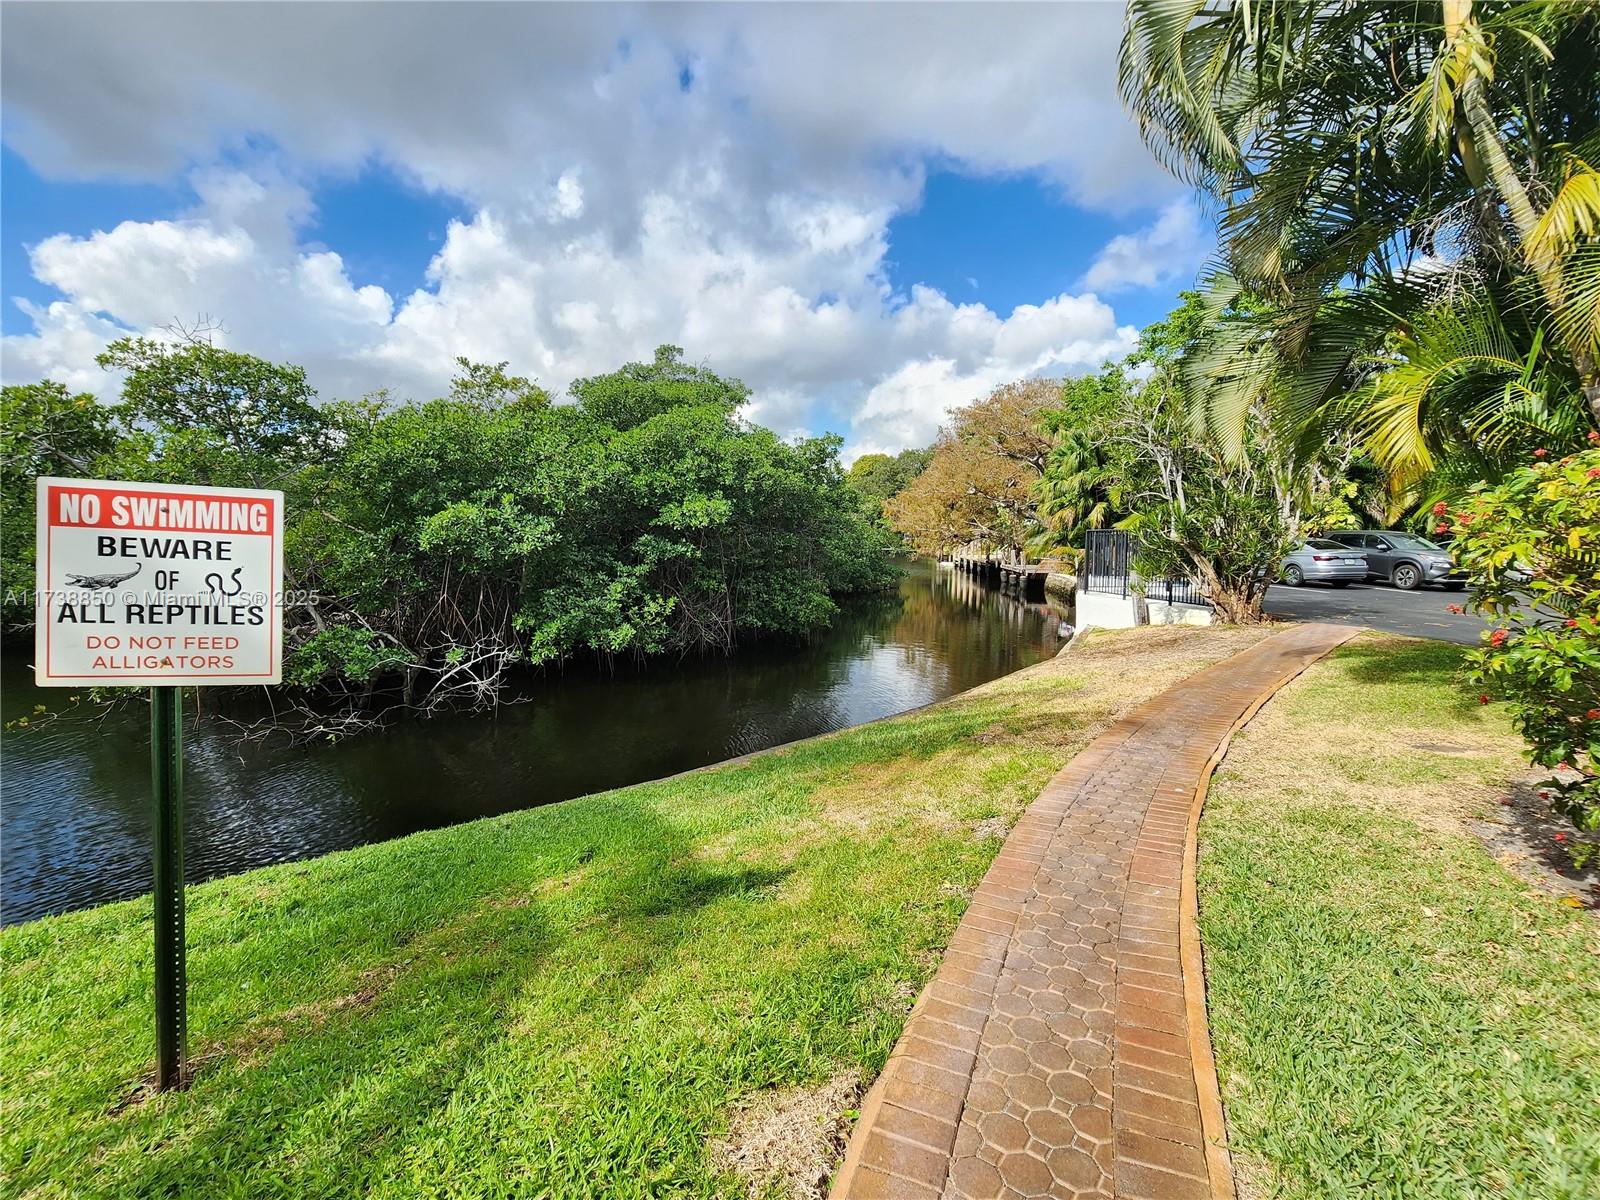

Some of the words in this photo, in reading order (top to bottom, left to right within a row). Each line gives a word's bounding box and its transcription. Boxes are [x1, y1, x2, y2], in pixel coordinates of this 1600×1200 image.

[60, 493, 100, 524] NO
[97, 536, 232, 560] BEWARE
[155, 570, 179, 590] OF
[58, 604, 115, 623] ALL
[126, 604, 264, 625] REPTILES
[87, 636, 120, 650] DO
[130, 637, 176, 649] NOT
[184, 637, 239, 650] FEED
[92, 656, 234, 669] ALLIGATORS
